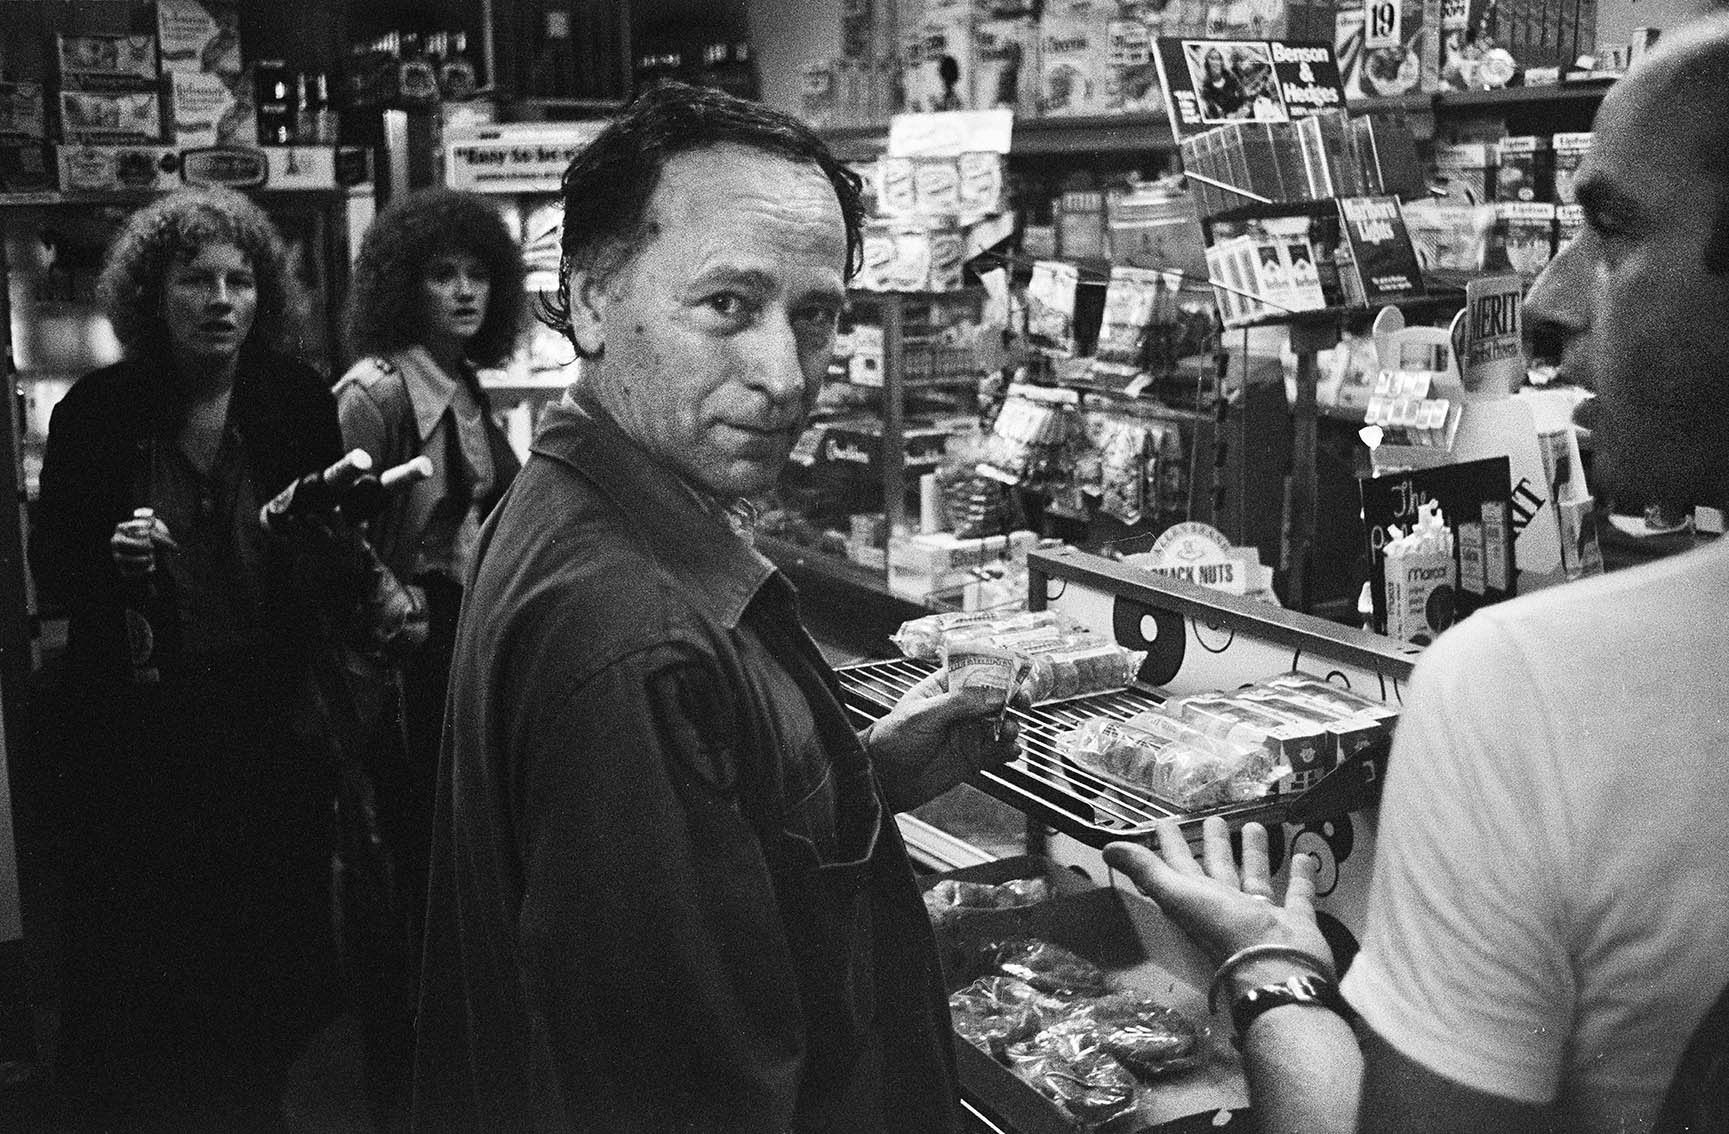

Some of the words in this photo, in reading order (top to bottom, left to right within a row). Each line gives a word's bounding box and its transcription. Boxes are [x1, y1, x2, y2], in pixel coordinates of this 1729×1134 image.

[1371, 3, 1394, 37] 19
[1271, 42, 1329, 62] Benson
[1299, 61, 1315, 82] &
[1283, 82, 1339, 107] Hedges
[1199, 563, 1233, 584] NUTS
